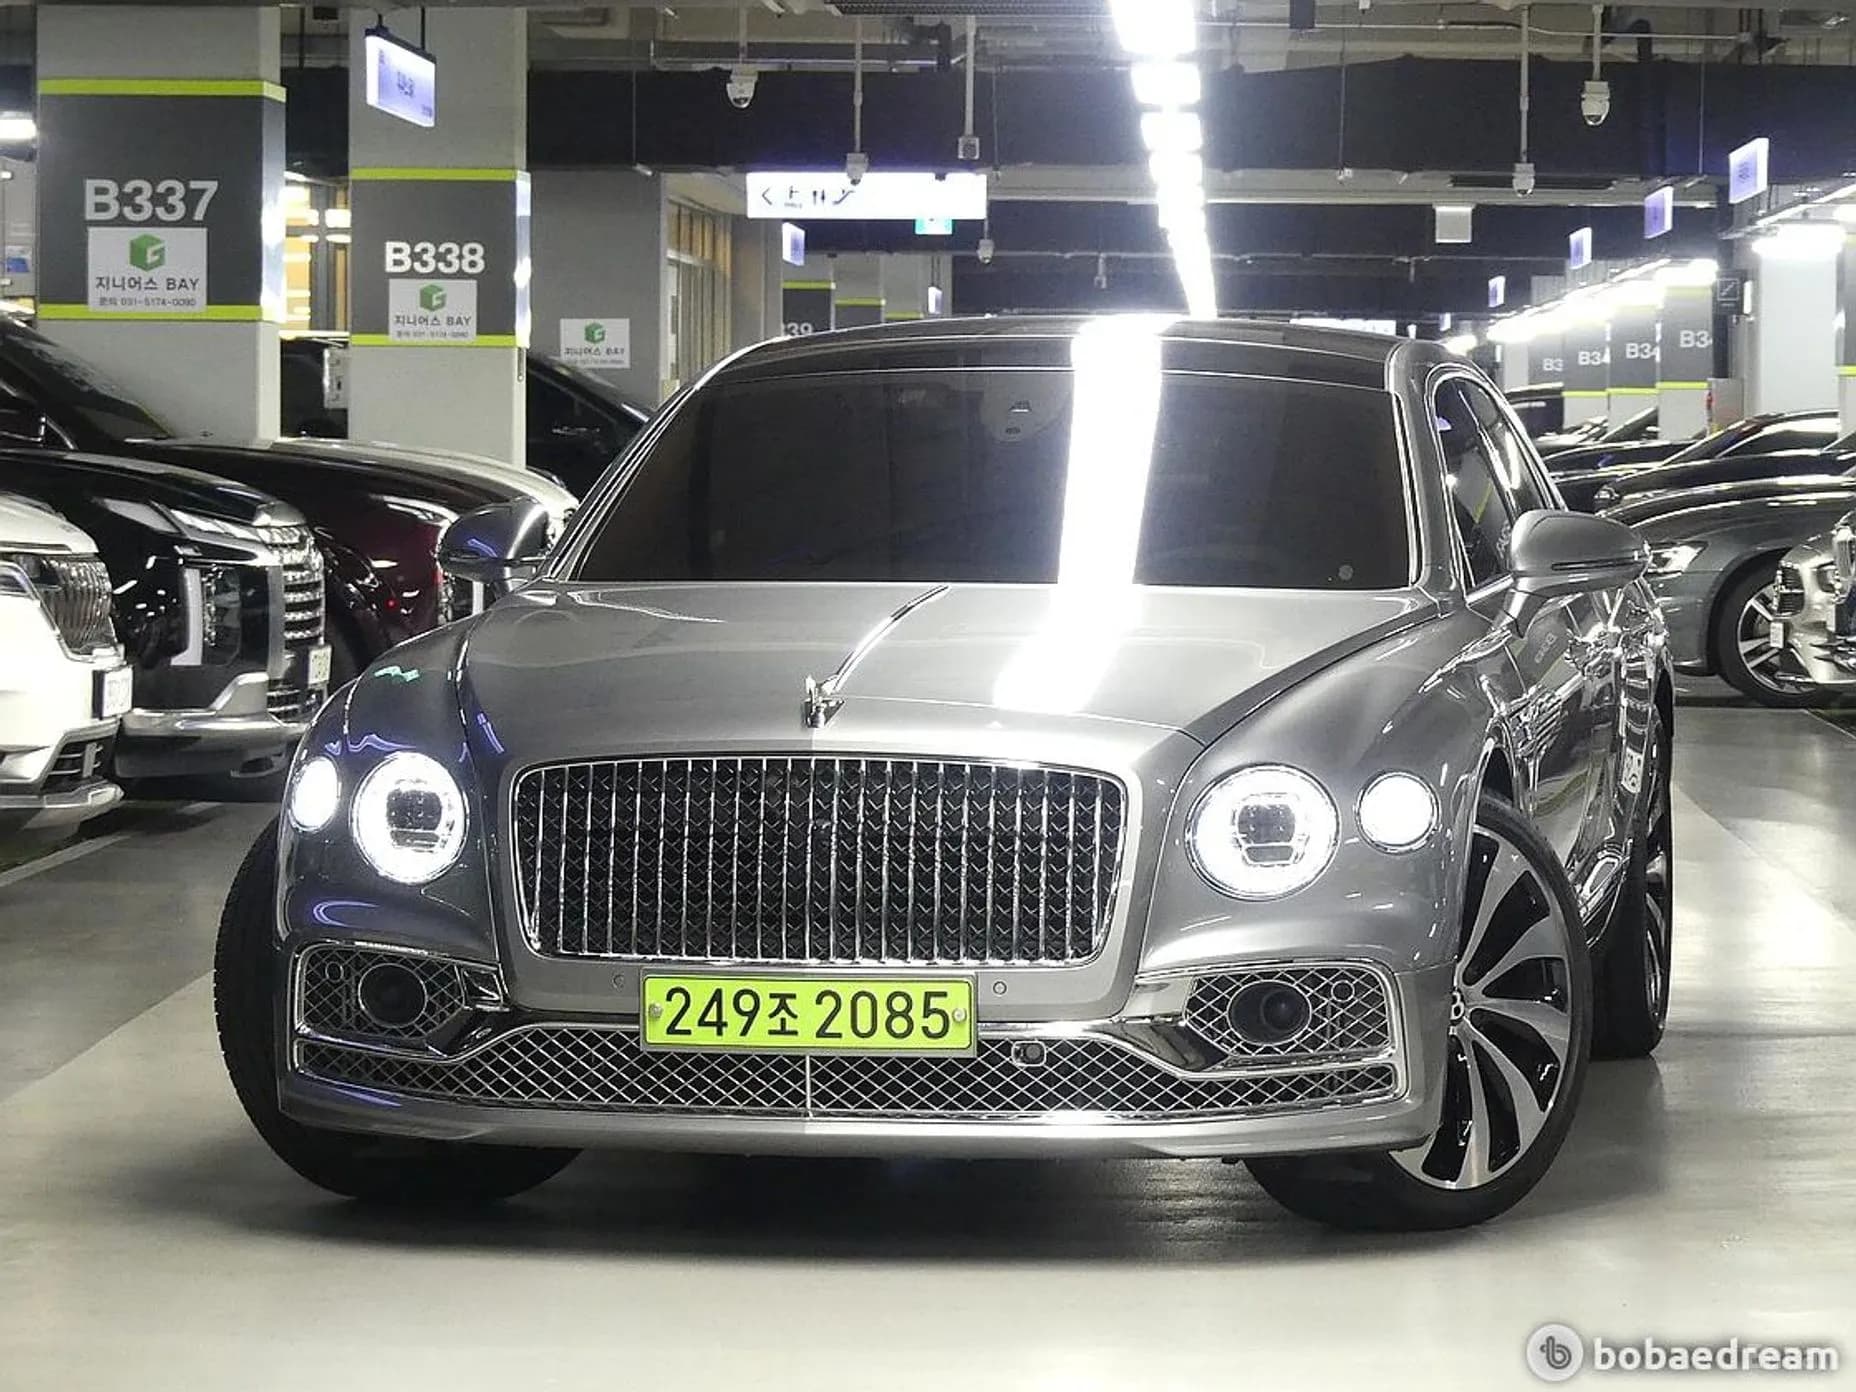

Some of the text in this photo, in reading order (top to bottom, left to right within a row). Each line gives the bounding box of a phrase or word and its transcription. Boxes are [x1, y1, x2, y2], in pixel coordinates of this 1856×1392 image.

[85, 178, 218, 221] B337
[385, 241, 485, 273] B338
[95, 276, 199, 291] 지니어스 BAY
[446, 316, 471, 326] BAY
[783, 322, 812, 337] 39
[1680, 330, 1713, 348] B3
[665, 986, 950, 1040] 249조 2085
